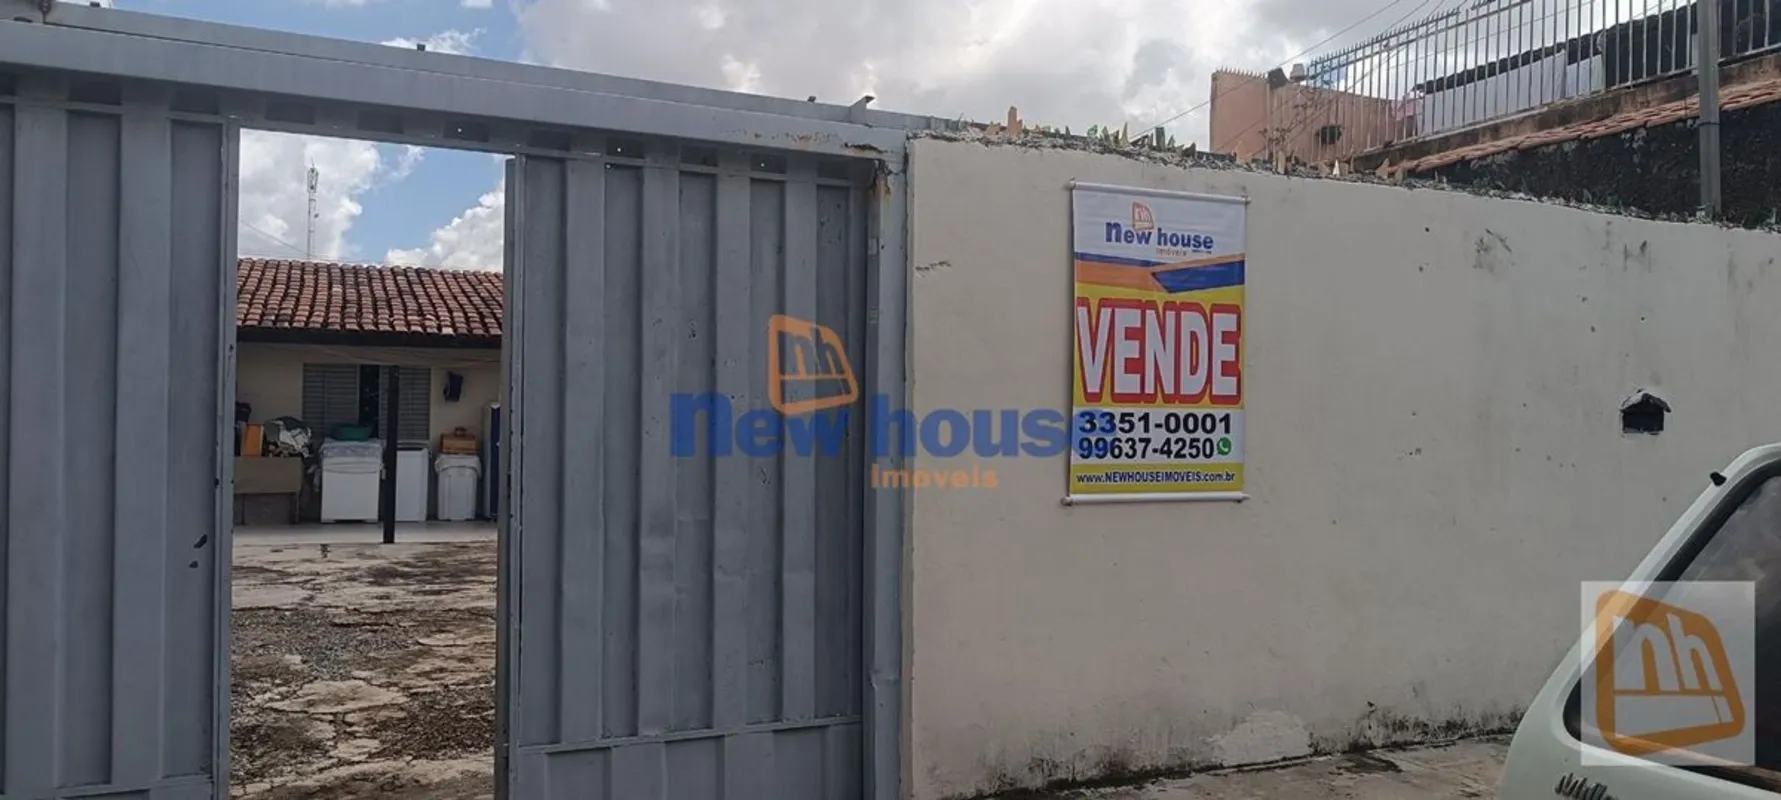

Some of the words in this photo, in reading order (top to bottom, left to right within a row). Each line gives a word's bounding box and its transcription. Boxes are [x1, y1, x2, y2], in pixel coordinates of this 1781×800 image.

[1157, 228, 1214, 250] house
[1077, 306, 1238, 396] VENDE
[1079, 411, 1231, 434] 3351-0001
[1079, 437, 1215, 459] 99637-4250
[1077, 472, 1236, 484] www.NEWHOUSEIMOVEIS.com.br
